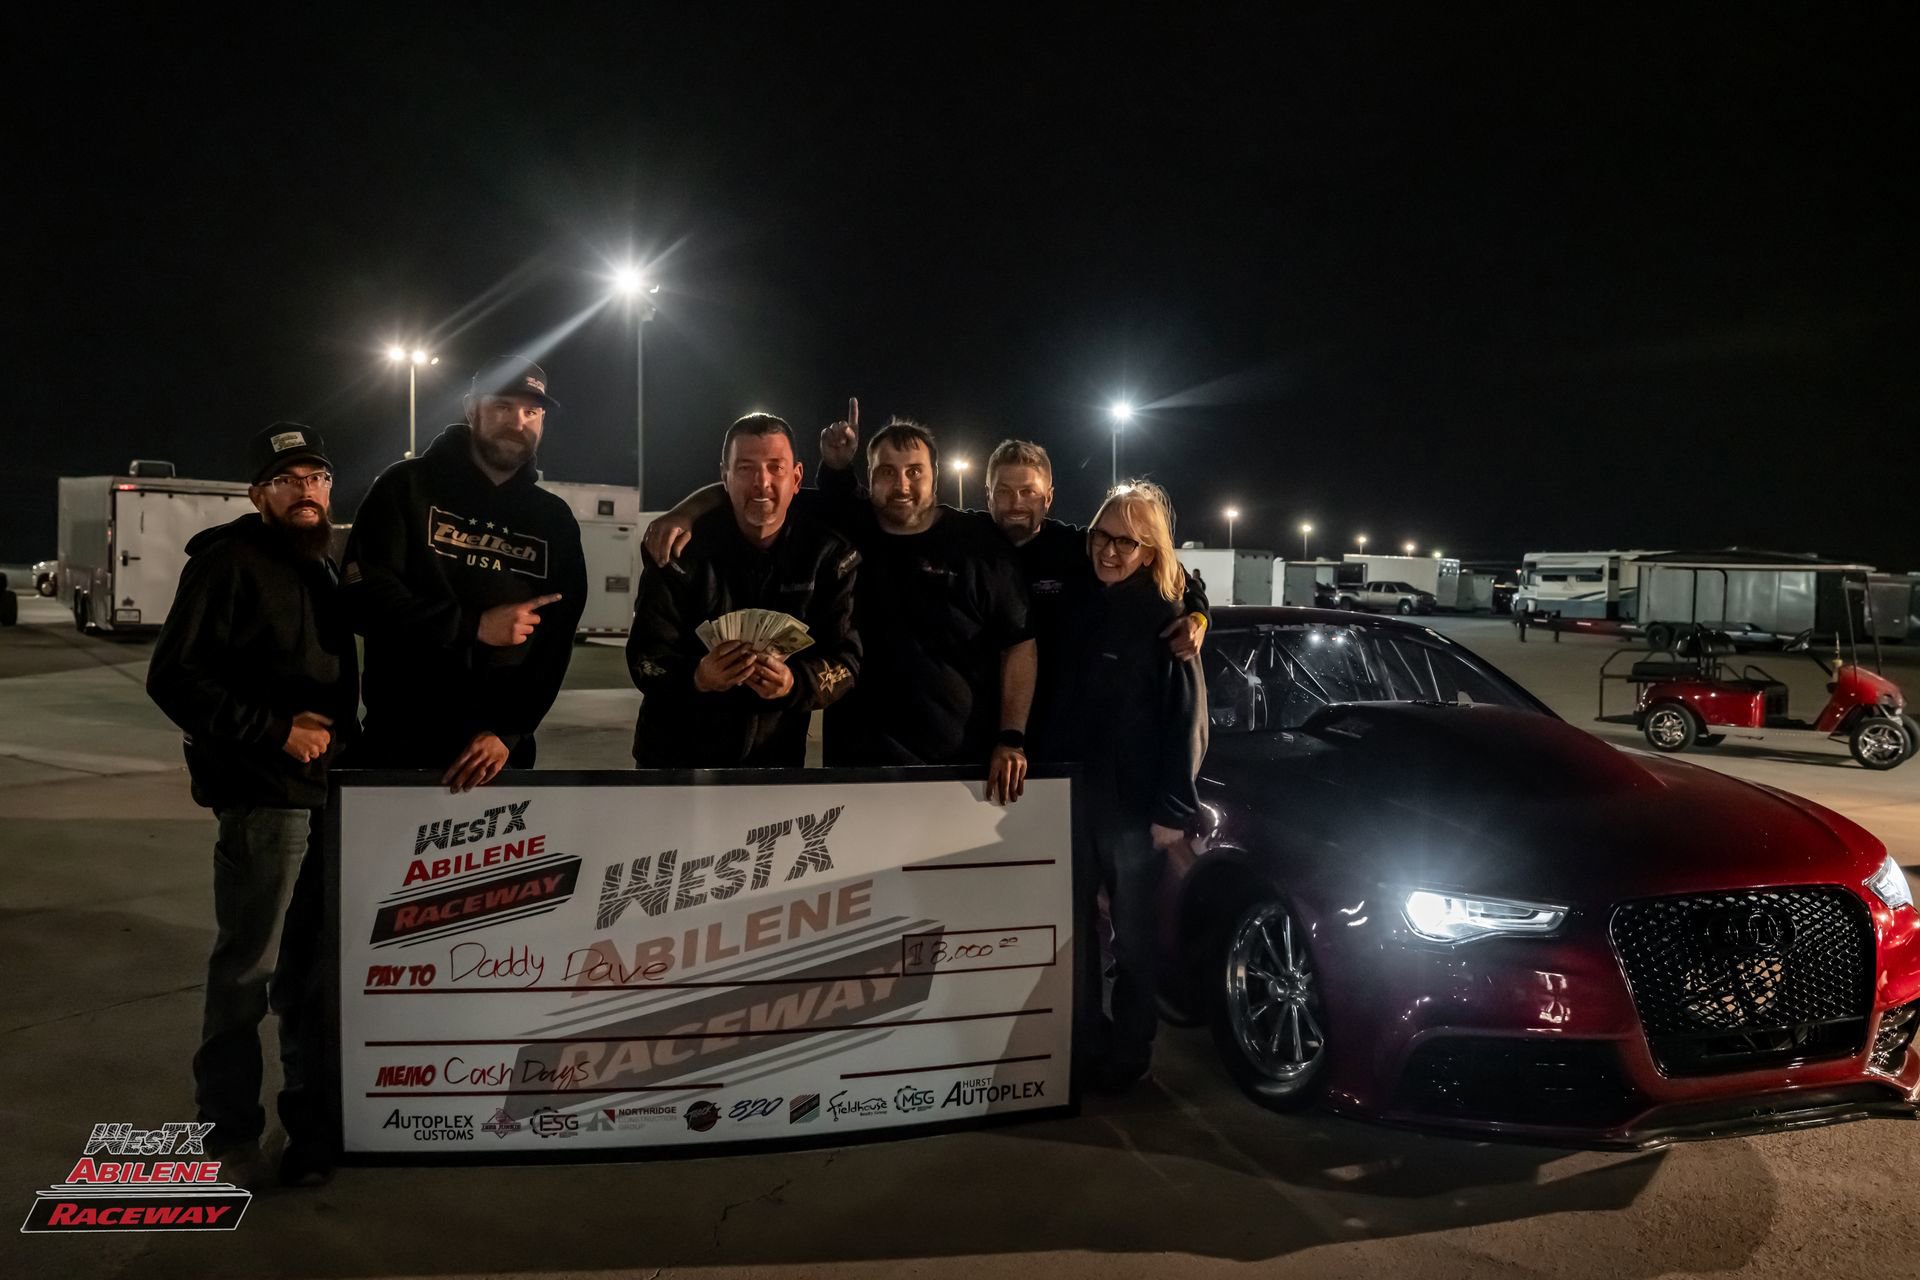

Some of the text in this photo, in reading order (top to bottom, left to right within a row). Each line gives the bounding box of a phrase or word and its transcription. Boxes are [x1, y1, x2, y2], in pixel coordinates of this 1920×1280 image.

[434, 522, 537, 562] FuelTech
[466, 554, 502, 571] USA
[403, 835, 546, 886] ABILENE
[393, 874, 566, 932] RACEWAY
[571, 880, 873, 997] ABILENE
[366, 963, 436, 987] PAY TO
[449, 942, 669, 989] Daddy Dave
[552, 966, 904, 1087] RACEWAY
[375, 1065, 436, 1087] MEMO
[444, 1057, 593, 1091] Cash Days
[962, 1078, 992, 1088] HURST
[827, 1090, 888, 1122] Fieldhouse
[902, 1090, 935, 1107] MSG
[941, 1081, 1046, 1108] AUTOPLEX
[382, 1108, 474, 1130] AUTOPLEX
[618, 1106, 677, 1117] NORTHRIDGE
[727, 1097, 784, 1122] 820
[414, 1129, 474, 1142] CUSTOMS
[539, 1114, 579, 1132] ESG
